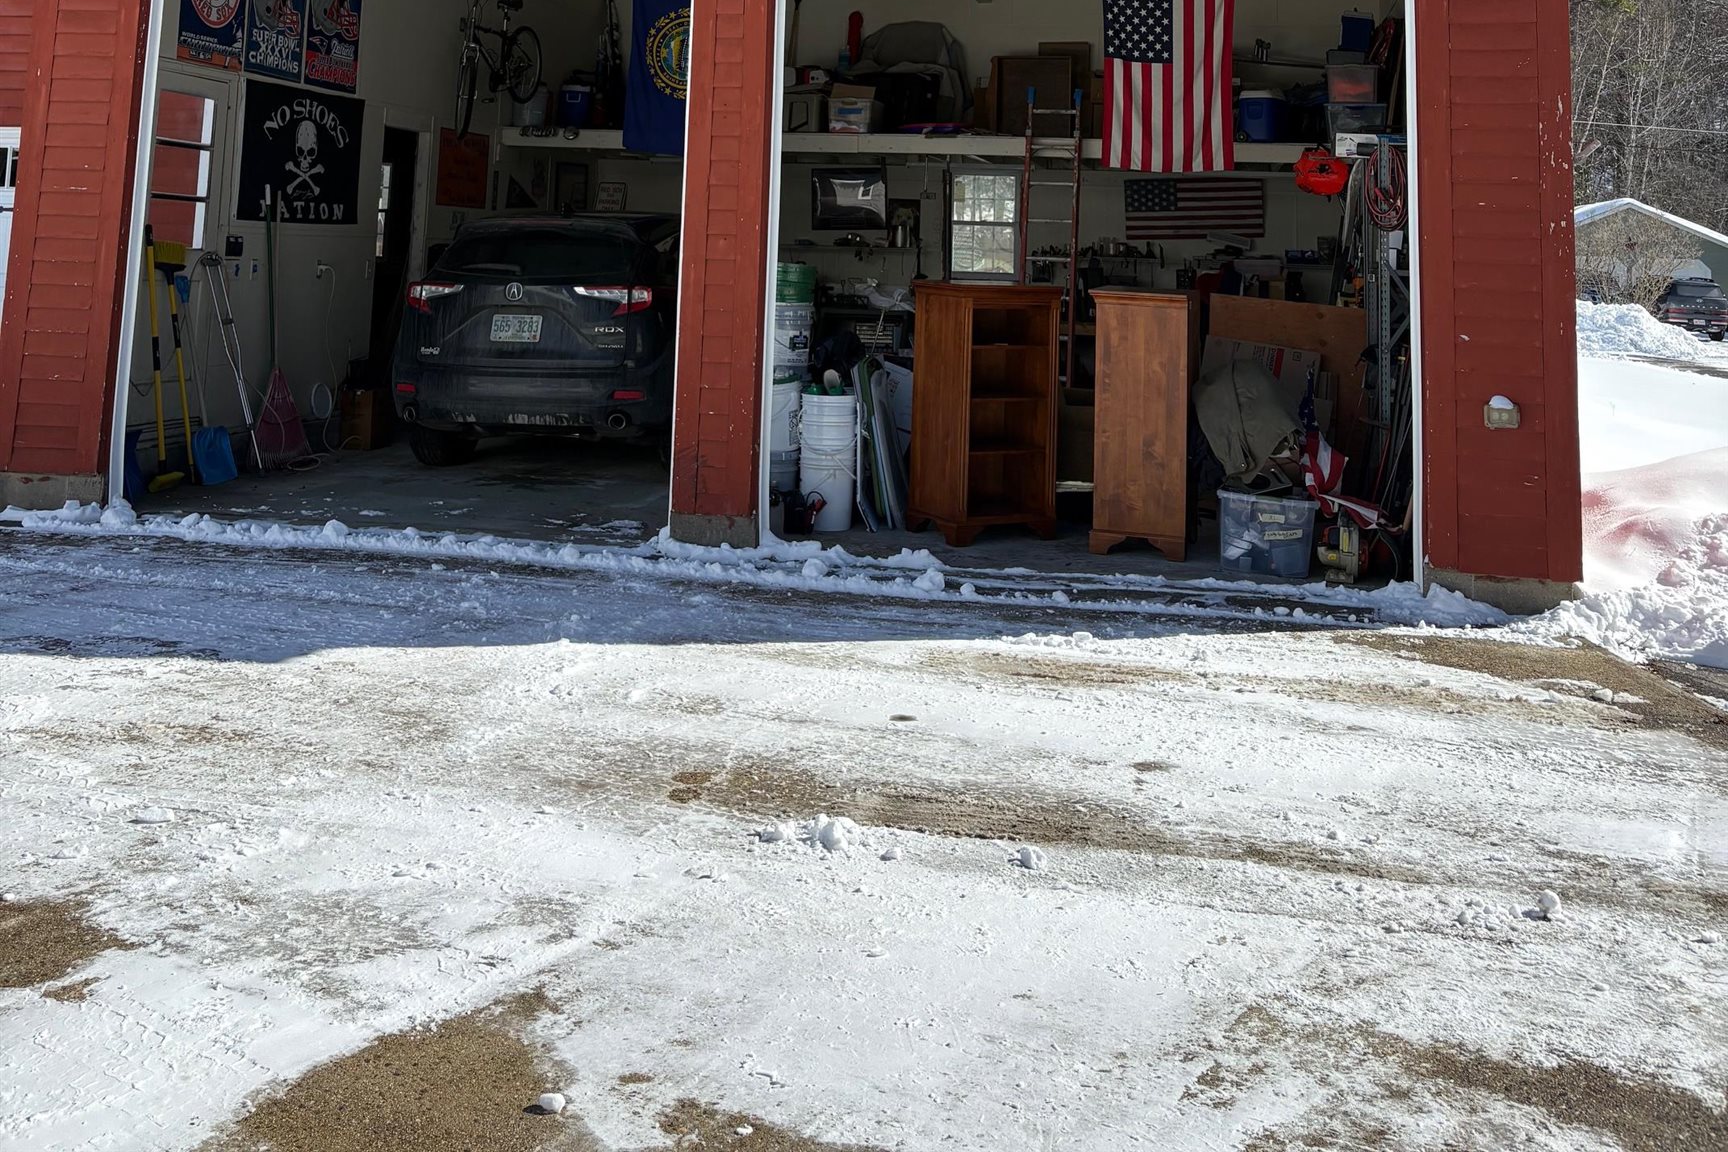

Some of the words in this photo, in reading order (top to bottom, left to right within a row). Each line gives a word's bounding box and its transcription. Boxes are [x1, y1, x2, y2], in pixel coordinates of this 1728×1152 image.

[216, 0, 234, 21] SOX
[182, 31, 200, 40] WORLD
[200, 35, 218, 44] SERIES
[278, 35, 300, 52] BOWL
[258, 41, 292, 60] XXXVI
[248, 51, 299, 73] CHMPIONS
[308, 58, 356, 87] CHAMPIONS
[263, 105, 291, 141] NO
[293, 98, 350, 149] SHOES
[494, 319, 512, 333] 565
[516, 319, 539, 334] 3283
